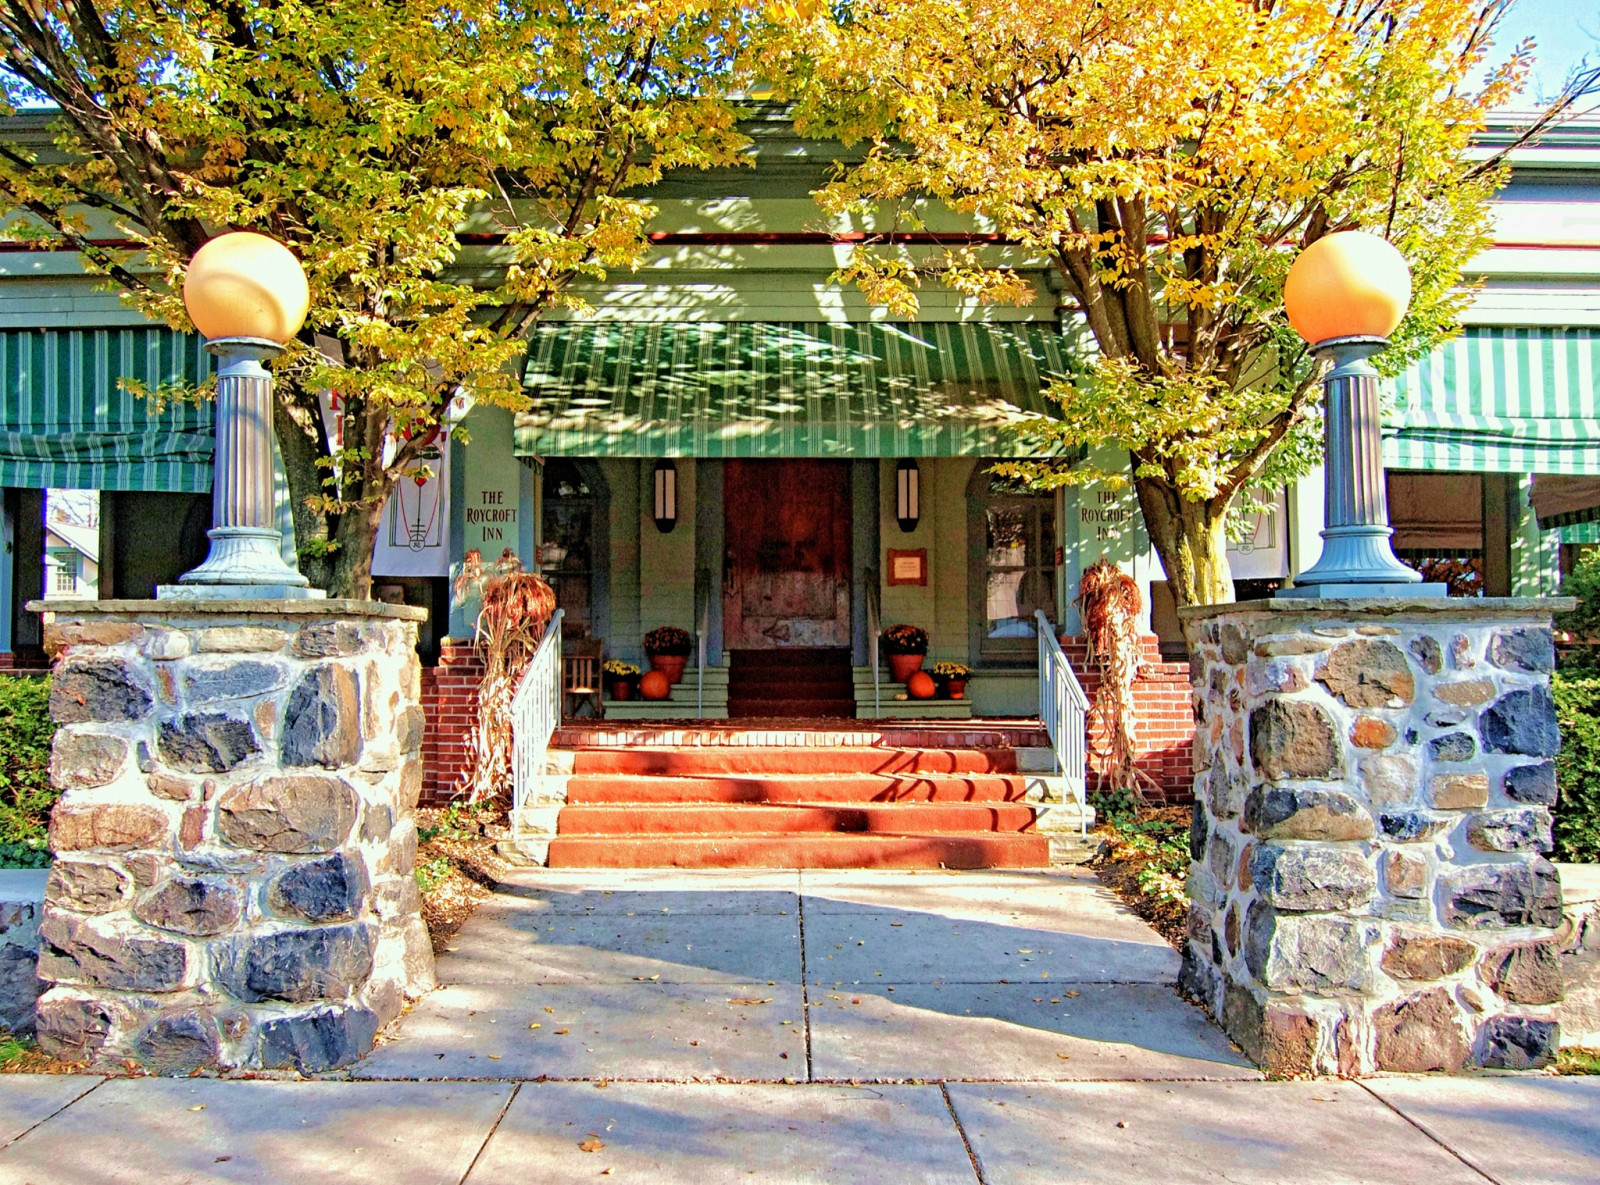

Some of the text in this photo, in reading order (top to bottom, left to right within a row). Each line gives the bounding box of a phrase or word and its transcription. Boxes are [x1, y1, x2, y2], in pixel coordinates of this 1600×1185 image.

[481, 491, 504, 505] THE
[466, 507, 518, 525] ROYCROFT
[482, 526, 503, 542] INN
